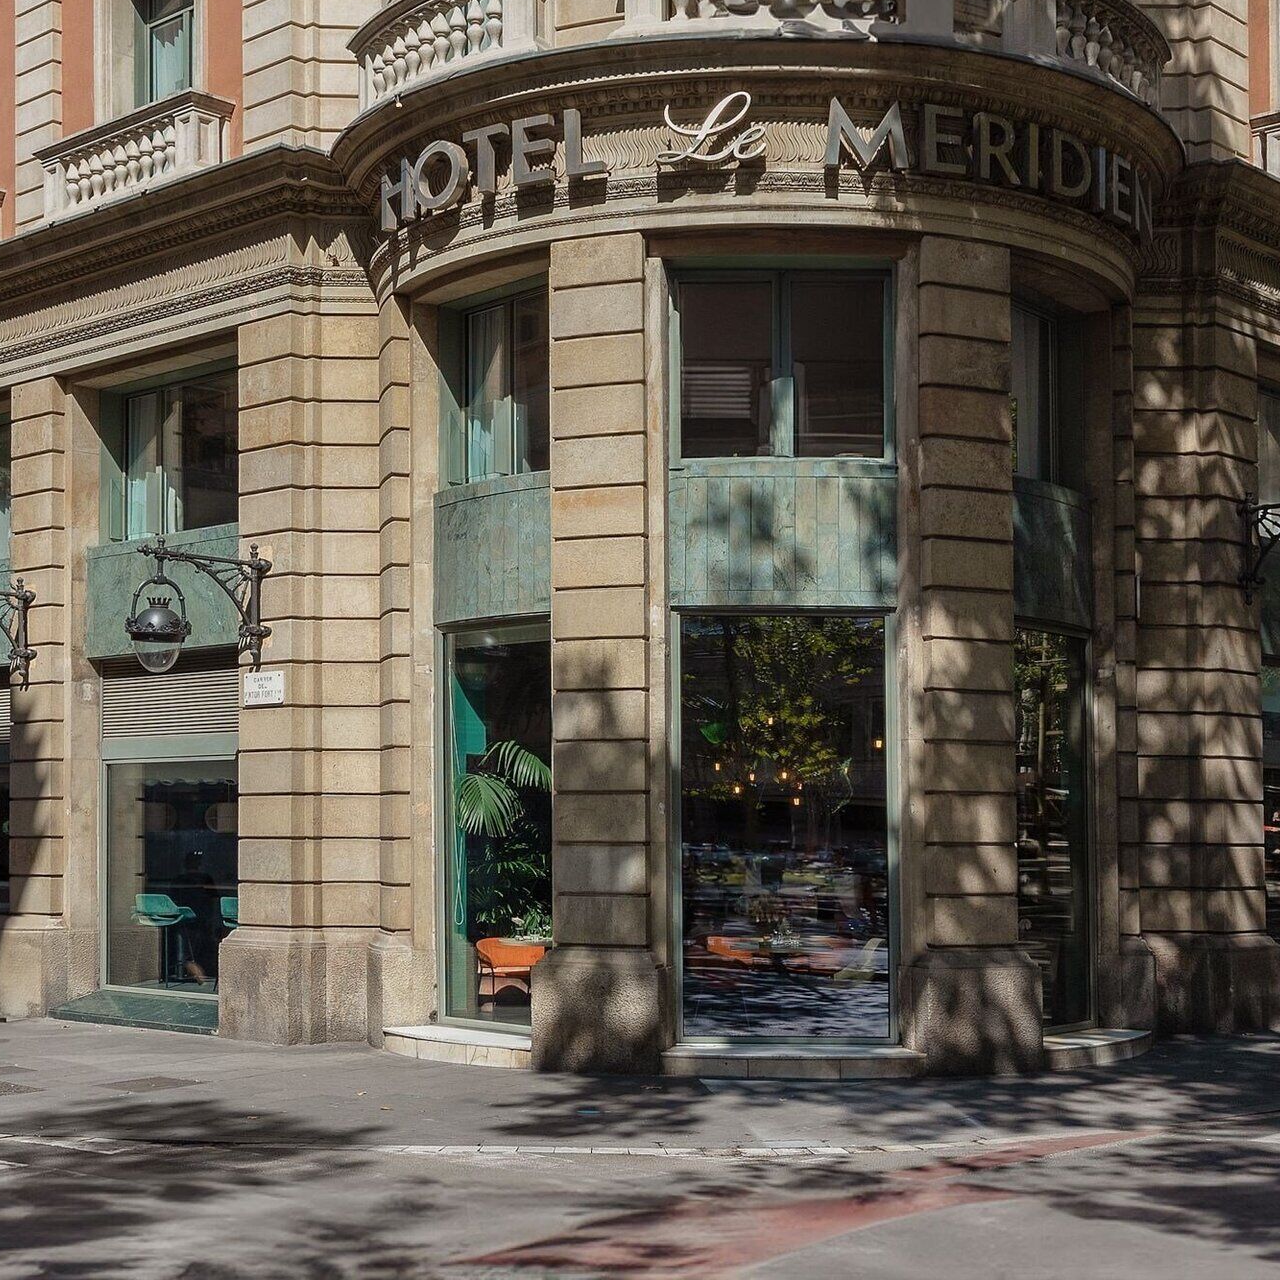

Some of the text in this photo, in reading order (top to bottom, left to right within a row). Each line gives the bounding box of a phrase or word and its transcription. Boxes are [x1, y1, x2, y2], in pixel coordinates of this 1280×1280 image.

[381, 91, 1154, 241] HOTEL Le MERIDIEN
